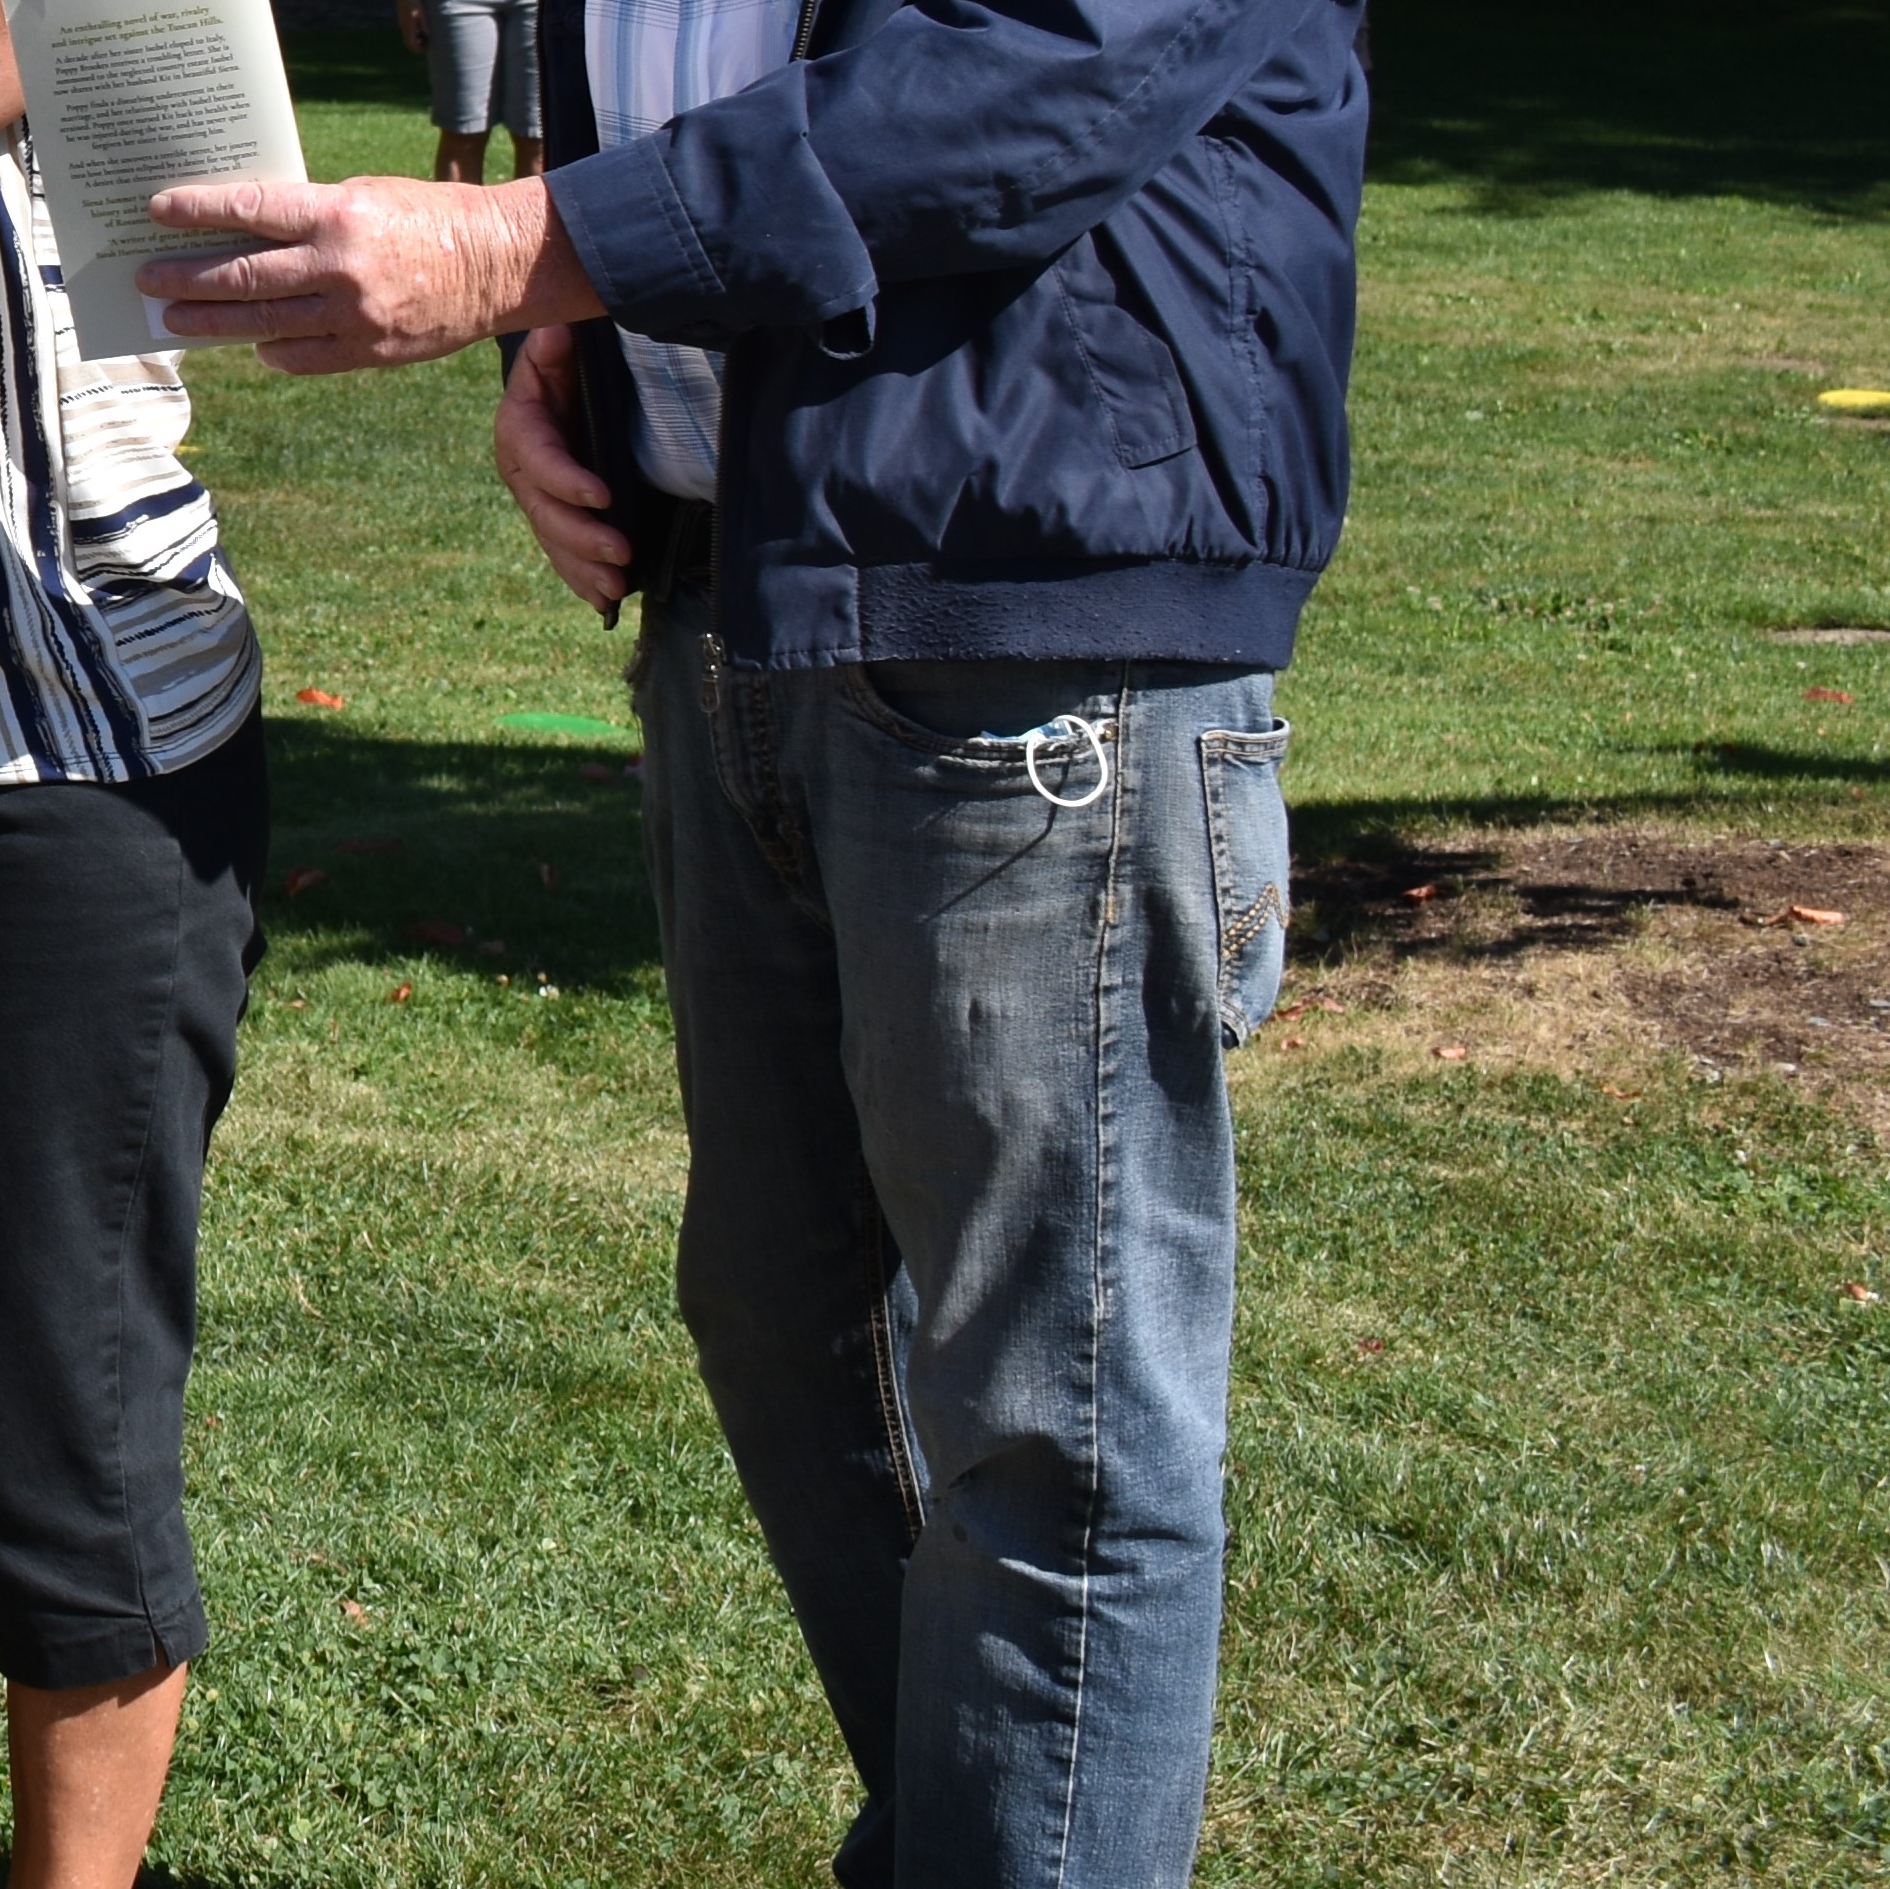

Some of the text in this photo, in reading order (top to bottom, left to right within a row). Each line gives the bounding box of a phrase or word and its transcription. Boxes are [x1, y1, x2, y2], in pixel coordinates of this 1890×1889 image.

[124, 14, 147, 25] novel
[149, 11, 158, 21] of
[181, 6, 209, 17] rivalry
[151, 25, 165, 34] the
[167, 22, 198, 32] Tuscan
